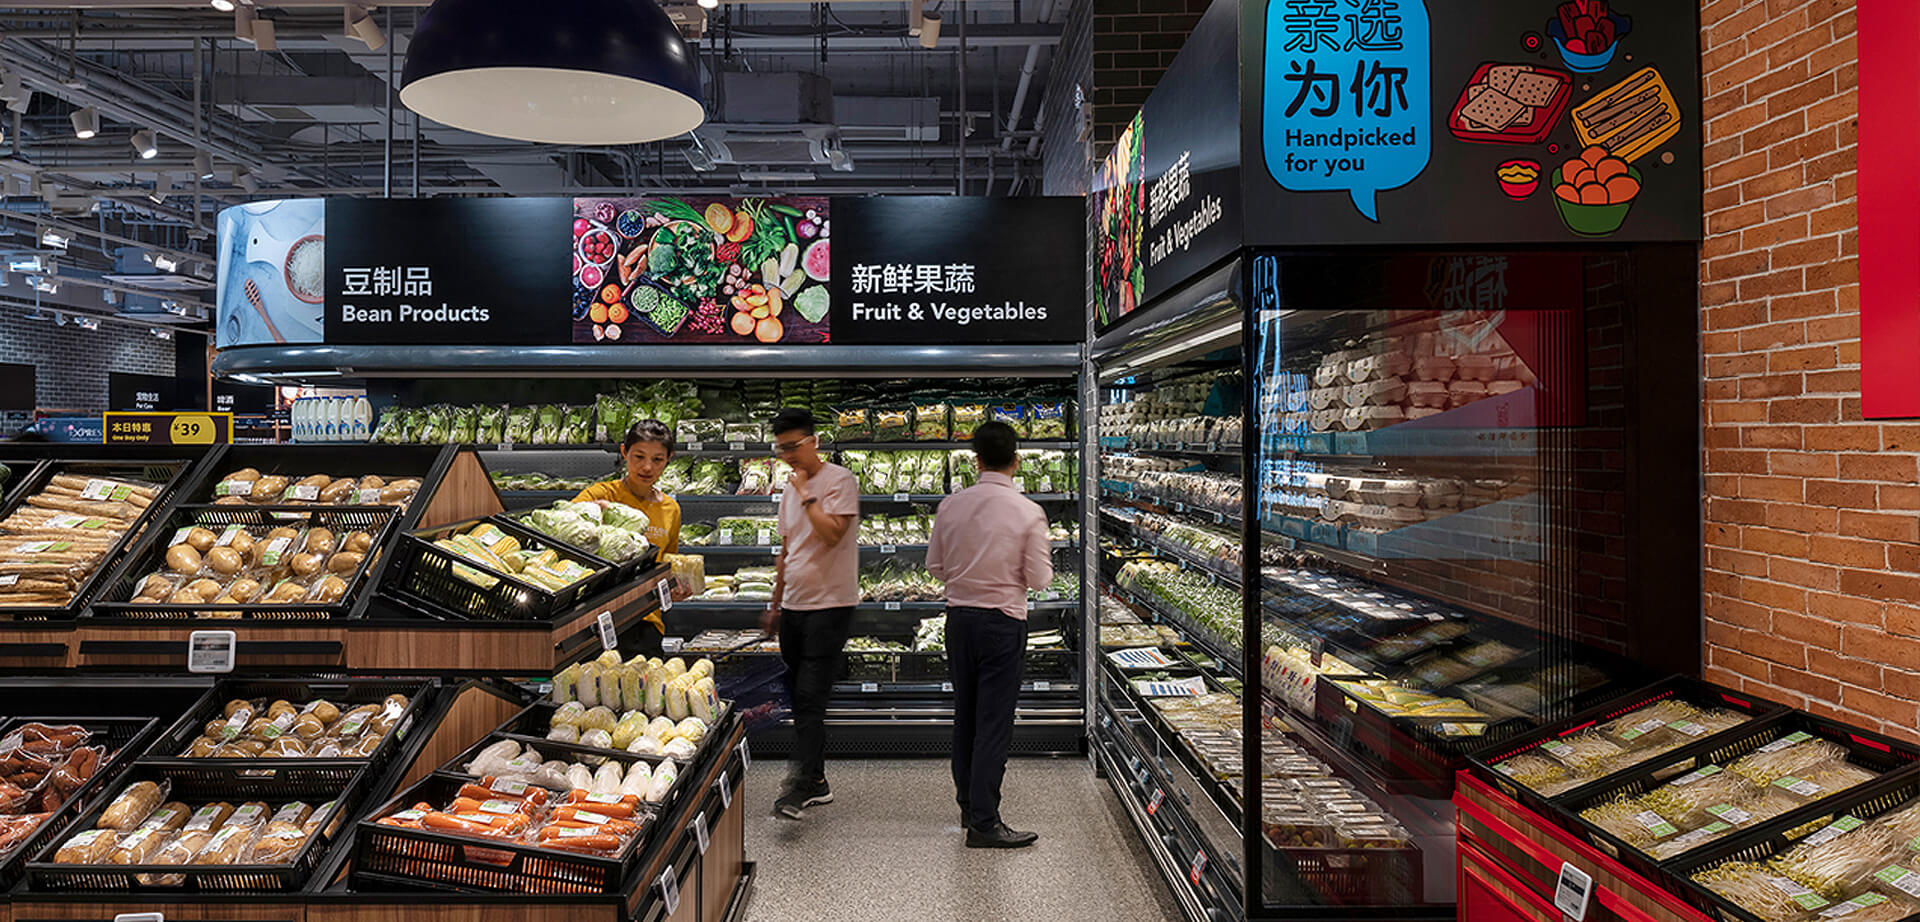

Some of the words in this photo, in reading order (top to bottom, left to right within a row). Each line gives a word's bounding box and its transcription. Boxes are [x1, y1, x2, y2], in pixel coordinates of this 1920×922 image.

[1283, 0, 1403, 53] 亲选
[1284, 59, 1409, 118] 为你
[1285, 126, 1416, 151] Handpicked
[1285, 152, 1317, 172] for
[1324, 158, 1365, 177] you
[1150, 151, 1190, 228] 新鲜果蔬
[1150, 236, 1166, 267] Fruit
[1167, 228, 1174, 255] &
[1174, 195, 1222, 251] Vegetables
[342, 266, 433, 297] 豆制品
[852, 263, 976, 294] 新鲜果蔬
[342, 304, 392, 322] Bean
[400, 303, 490, 322] Products
[852, 303, 901, 320] Fruit
[908, 303, 924, 320] &
[931, 302, 1048, 325] Vegetables
